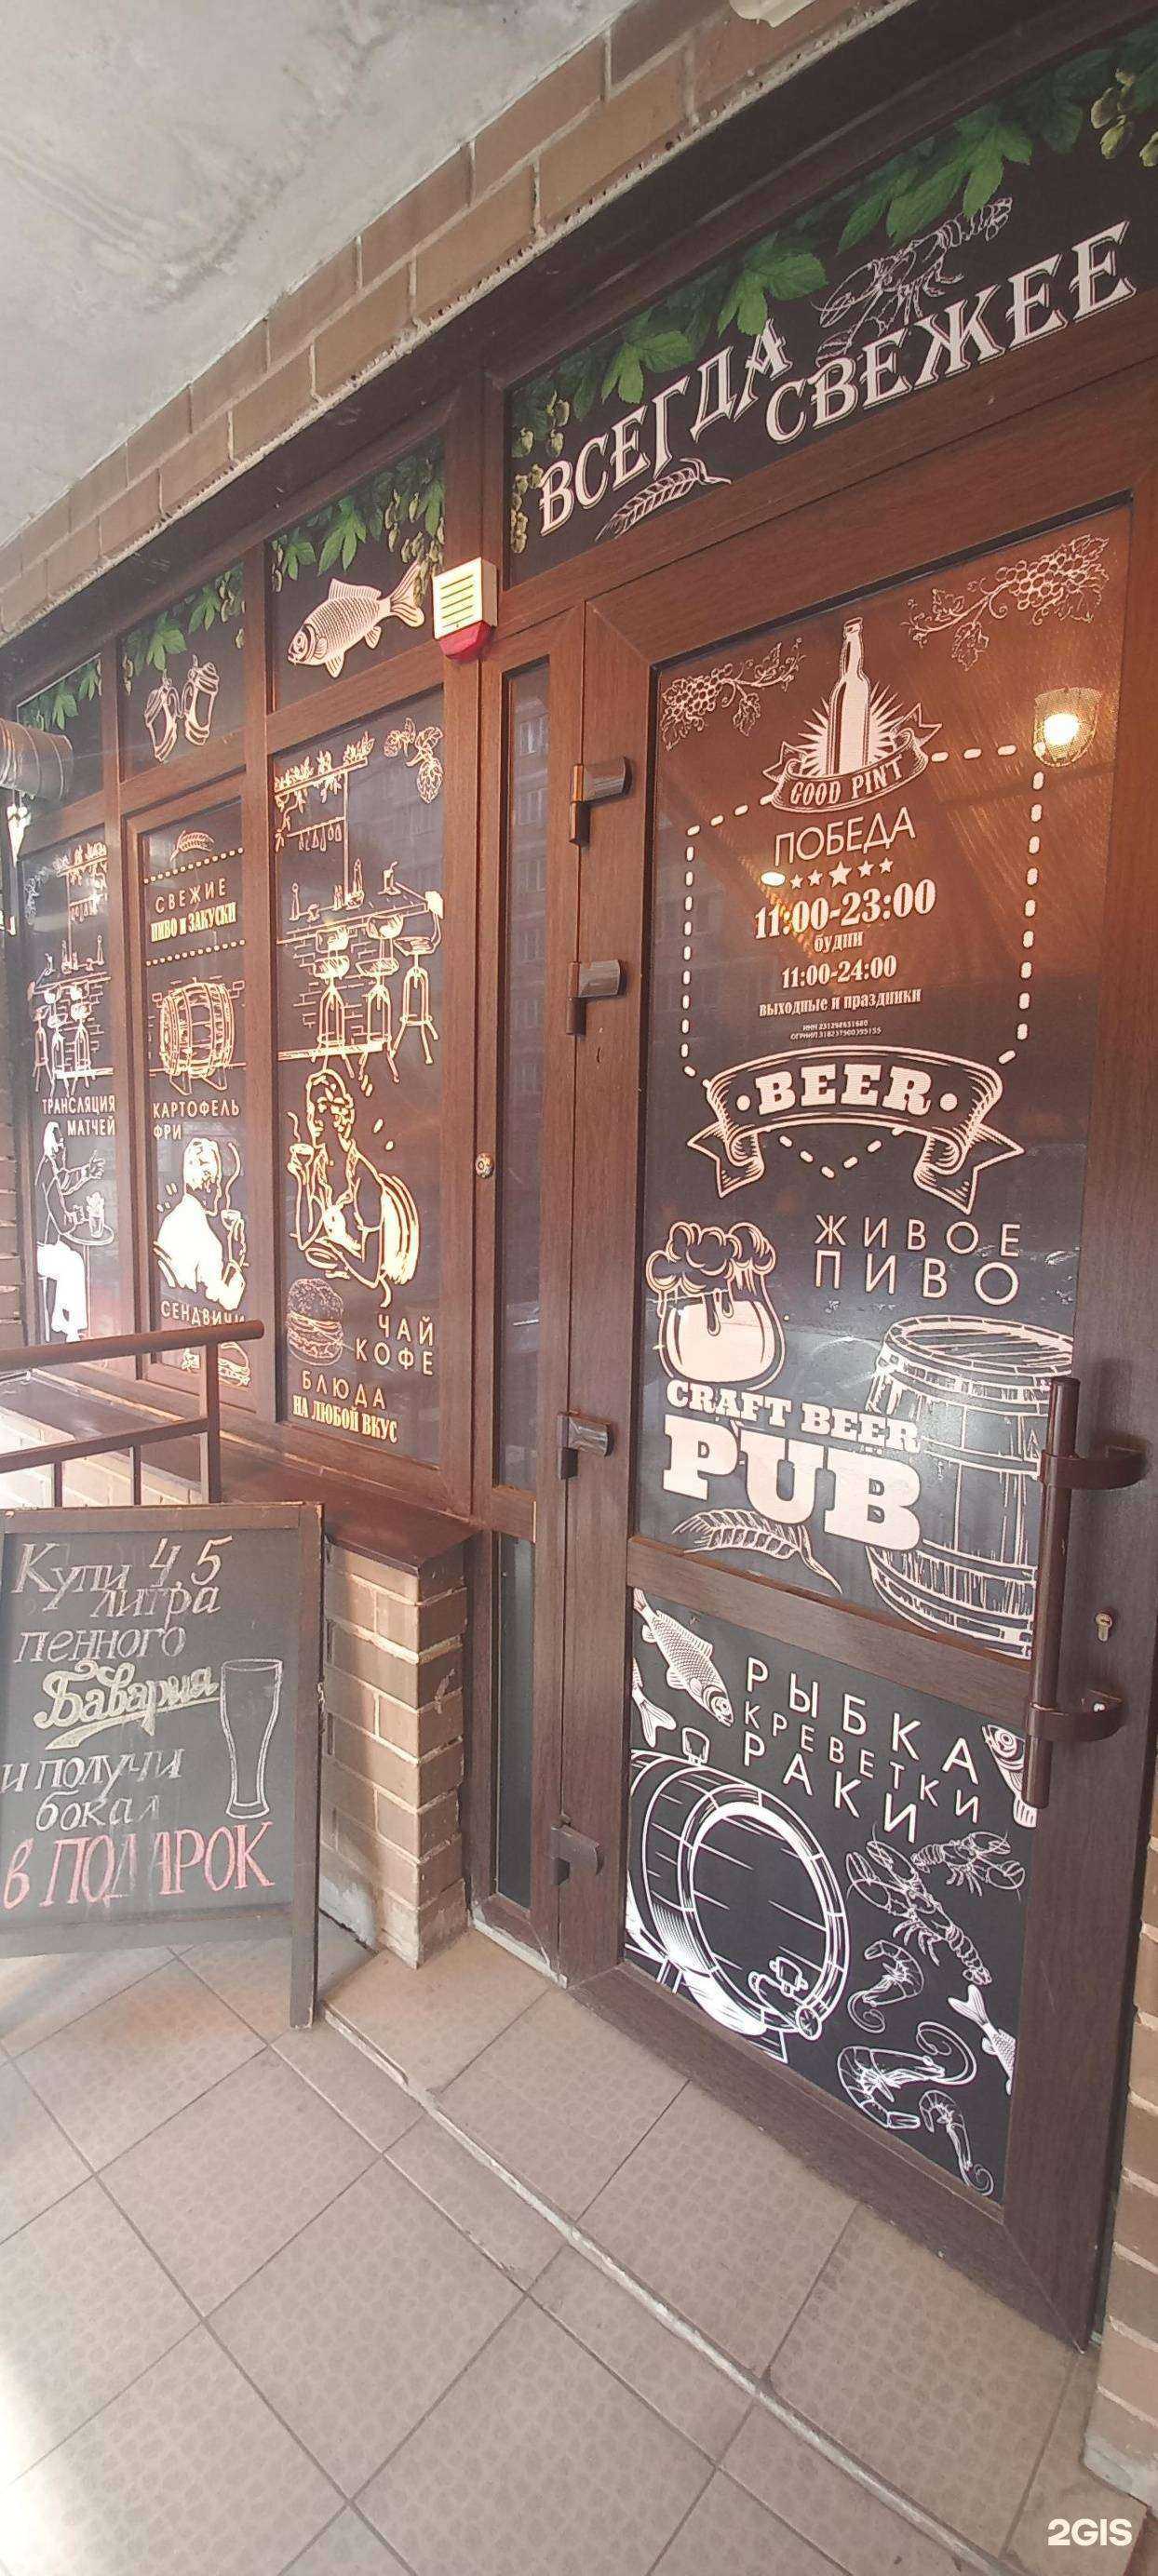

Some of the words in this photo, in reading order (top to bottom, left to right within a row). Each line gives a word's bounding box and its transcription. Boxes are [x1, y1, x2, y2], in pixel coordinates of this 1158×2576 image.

[765, 220, 1137, 445] СВЕЖЕЕ
[538, 317, 794, 537] ВСЕГДА
[789, 781, 842, 806] GOOD
[851, 754, 903, 800] PINT
[774, 806, 917, 866] ПОБЕДА
[155, 878, 226, 914] СВЕЖИЕ
[753, 879, 937, 940] 11:00-23:00
[150, 917, 179, 943] ПИВО
[188, 901, 237, 933] ЗАКУСКИ
[814, 931, 864, 954] будни
[781, 954, 898, 989] 11:00-24:00
[759, 997, 828, 1018] выходные
[830, 996, 841, 1012] и
[843, 988, 922, 1011] праздники
[42, 1094, 115, 1116] ТРАНСЛЯЦИЯ
[153, 1098, 240, 1119] КАРТОФЕЛЬ
[754, 1062, 932, 1116] BEER
[67, 1115, 116, 1137] МАТЧЕЙ
[153, 1123, 182, 1141] ФРИ
[814, 1214, 1021, 1258] ЖИВОЕ
[815, 1249, 1020, 1306] ПИВО
[378, 1313, 434, 1347] ЧАЙ
[356, 1337, 434, 1376] КОФЕ
[302, 1369, 386, 1410] БЛЮДА
[292, 1394, 309, 1419] НА
[311, 1399, 359, 1433] ЛЮБОЙ
[361, 1413, 398, 1443] ВКУС
[667, 1379, 792, 1429] CRAFT
[801, 1402, 922, 1454] BEER
[662, 1414, 922, 1551] PUB
[11, 1542, 132, 1612] Купи
[89, 1584, 222, 1630] литра
[13, 1626, 188, 1663] пенного
[33, 1660, 221, 1737] Бавария
[746, 1656, 979, 1786] РЫБКА
[0, 1762, 31, 1794] и
[34, 1748, 185, 1804] получи
[744, 1700, 980, 1824] КРЕВЕТКИ
[35, 1789, 162, 1831] бокал
[744, 1730, 918, 1845] РАКИ
[39, 1820, 276, 1908] ПОДАРОК
